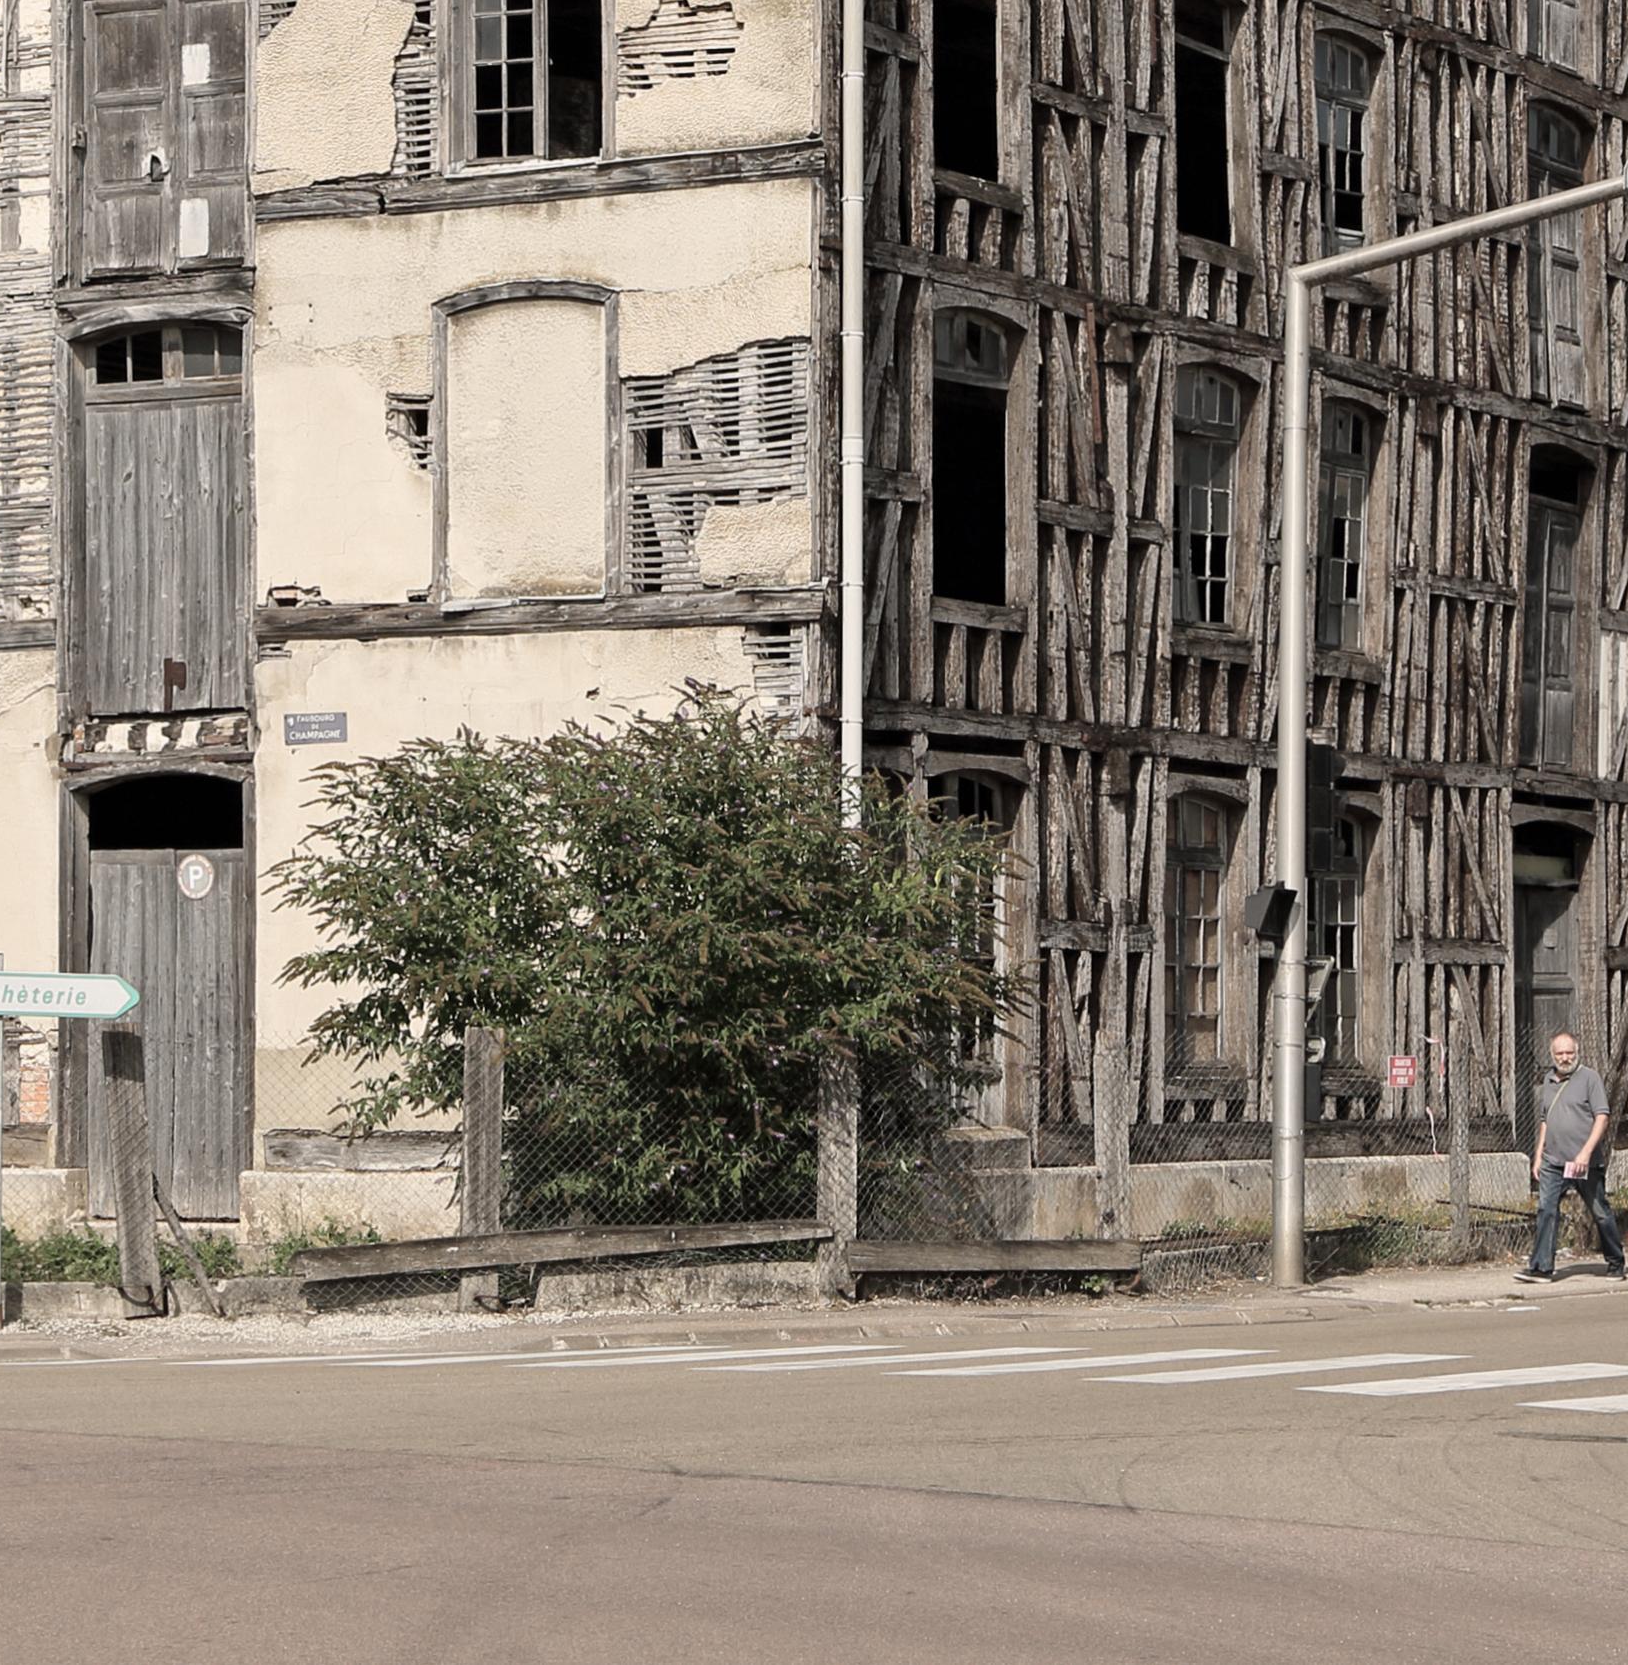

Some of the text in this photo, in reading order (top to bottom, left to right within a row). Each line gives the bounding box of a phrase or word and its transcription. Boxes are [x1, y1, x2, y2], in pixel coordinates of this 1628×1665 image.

[296, 714, 335, 723] FAUBOURG
[289, 729, 341, 740] CHAMPAGNE
[189, 865, 203, 889] P
